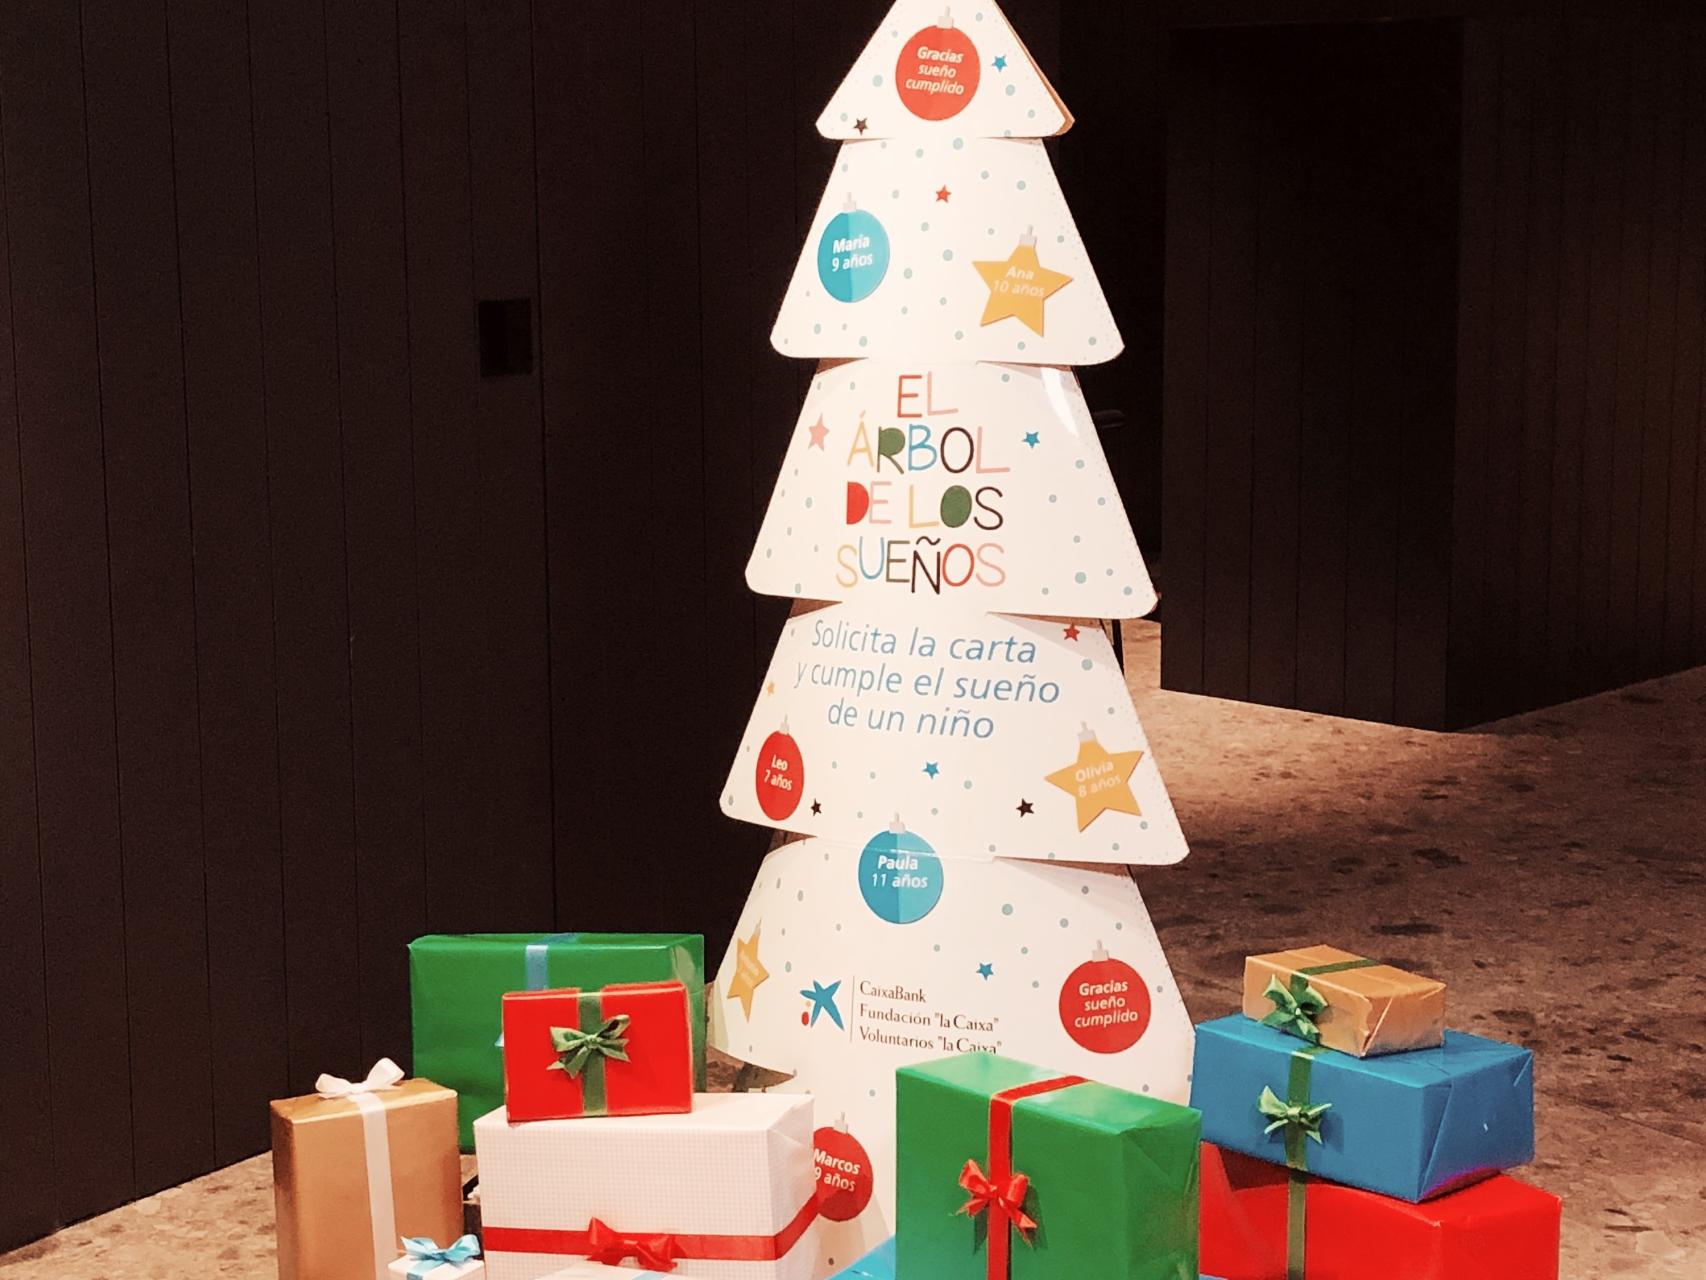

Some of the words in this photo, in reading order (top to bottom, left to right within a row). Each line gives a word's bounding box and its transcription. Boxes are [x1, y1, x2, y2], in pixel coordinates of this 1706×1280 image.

[917, 46, 964, 63] Gracias
[918, 63, 956, 78] sueño
[905, 78, 964, 95] cumplido
[832, 234, 870, 254] María
[832, 257, 840, 272] 9
[842, 253, 874, 270] años
[1006, 265, 1035, 280] Ana
[993, 280, 1009, 293] 10
[1011, 283, 1046, 297] años
[897, 371, 958, 418] EL
[846, 409, 1011, 475] ÁRBOL
[846, 480, 892, 525] DE
[909, 484, 1004, 531] LOS
[835, 535, 1006, 594] SUEÑOS
[811, 619, 897, 655] Solicita
[908, 627, 936, 658] la
[948, 635, 1037, 663] carta
[793, 661, 808, 690] y
[811, 662, 902, 698] cumple
[913, 667, 945, 697] el
[953, 673, 1060, 703] sueño
[827, 697, 858, 728] de
[867, 708, 905, 732] un
[916, 706, 994, 738] niño
[771, 754, 788, 771] Leo
[1075, 760, 1114, 782] Olivia
[764, 768, 771, 783] 7
[770, 773, 793, 791] años
[1078, 784, 1087, 798] 8
[877, 854, 918, 870] Paula
[872, 873, 887, 887] 11
[891, 873, 929, 889] años
[859, 980, 927, 1003] CaixaBank
[1078, 979, 1129, 996] Gracias
[859, 1002, 931, 1026] Fundación
[1084, 995, 1126, 1012] sueño
[1074, 1008, 1139, 1029] cumplido
[859, 1025, 934, 1050] Voluntarios
[813, 1148, 861, 1175] Marcos
[814, 1166, 822, 1181] 9
[823, 1172, 857, 1192] años
